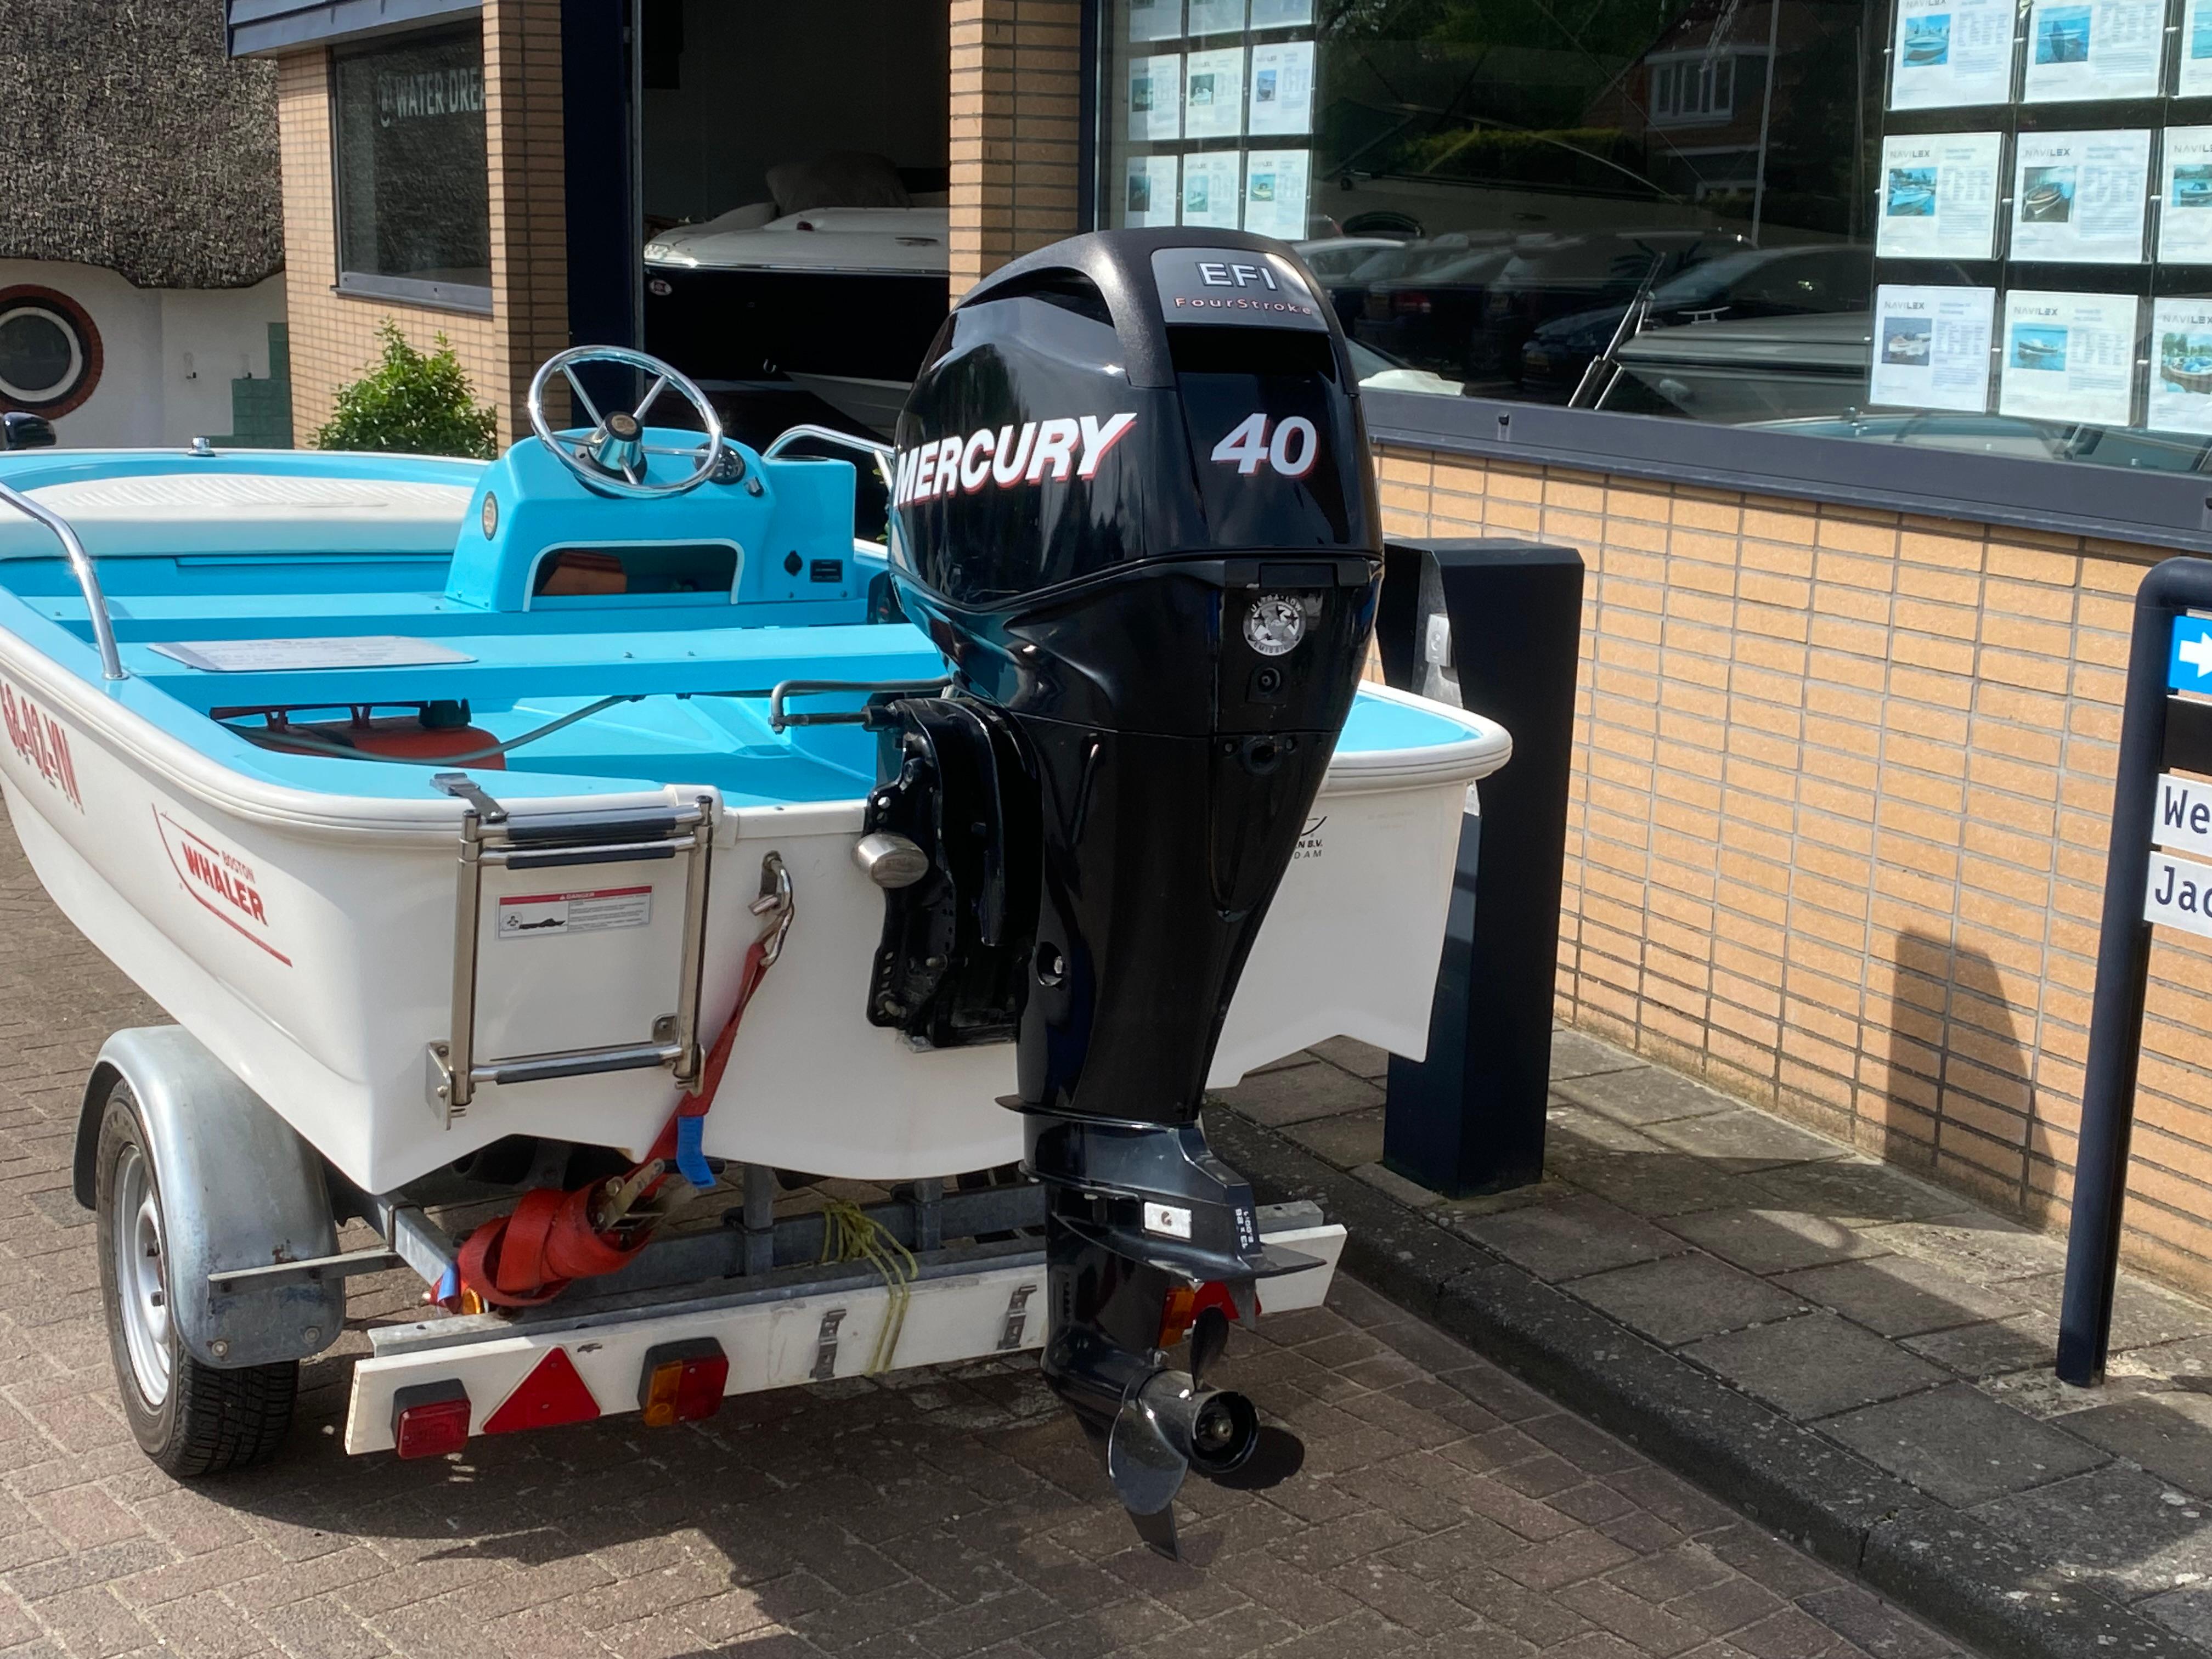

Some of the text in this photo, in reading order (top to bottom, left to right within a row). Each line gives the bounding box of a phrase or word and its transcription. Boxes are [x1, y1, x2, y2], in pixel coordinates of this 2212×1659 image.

[396, 72, 445, 119] WATER
[1890, 150, 1931, 159] NAVILEX
[2025, 148, 2071, 157] NAVILEX
[2174, 144, 2212, 153] NAVIL
[1196, 262, 1278, 291] EFI
[1175, 297, 1312, 315] FourStroke
[1884, 301, 1925, 310] NAVILEX
[2014, 307, 2058, 316] NAVILEX
[2162, 314, 2212, 324] NAVILEX
[1211, 413, 1321, 478] 40
[894, 413, 1137, 508] MERCURY
[2164, 785, 2210, 834] We
[1308, 839, 1323, 848] B.V.
[181, 840, 269, 928] WHALER
